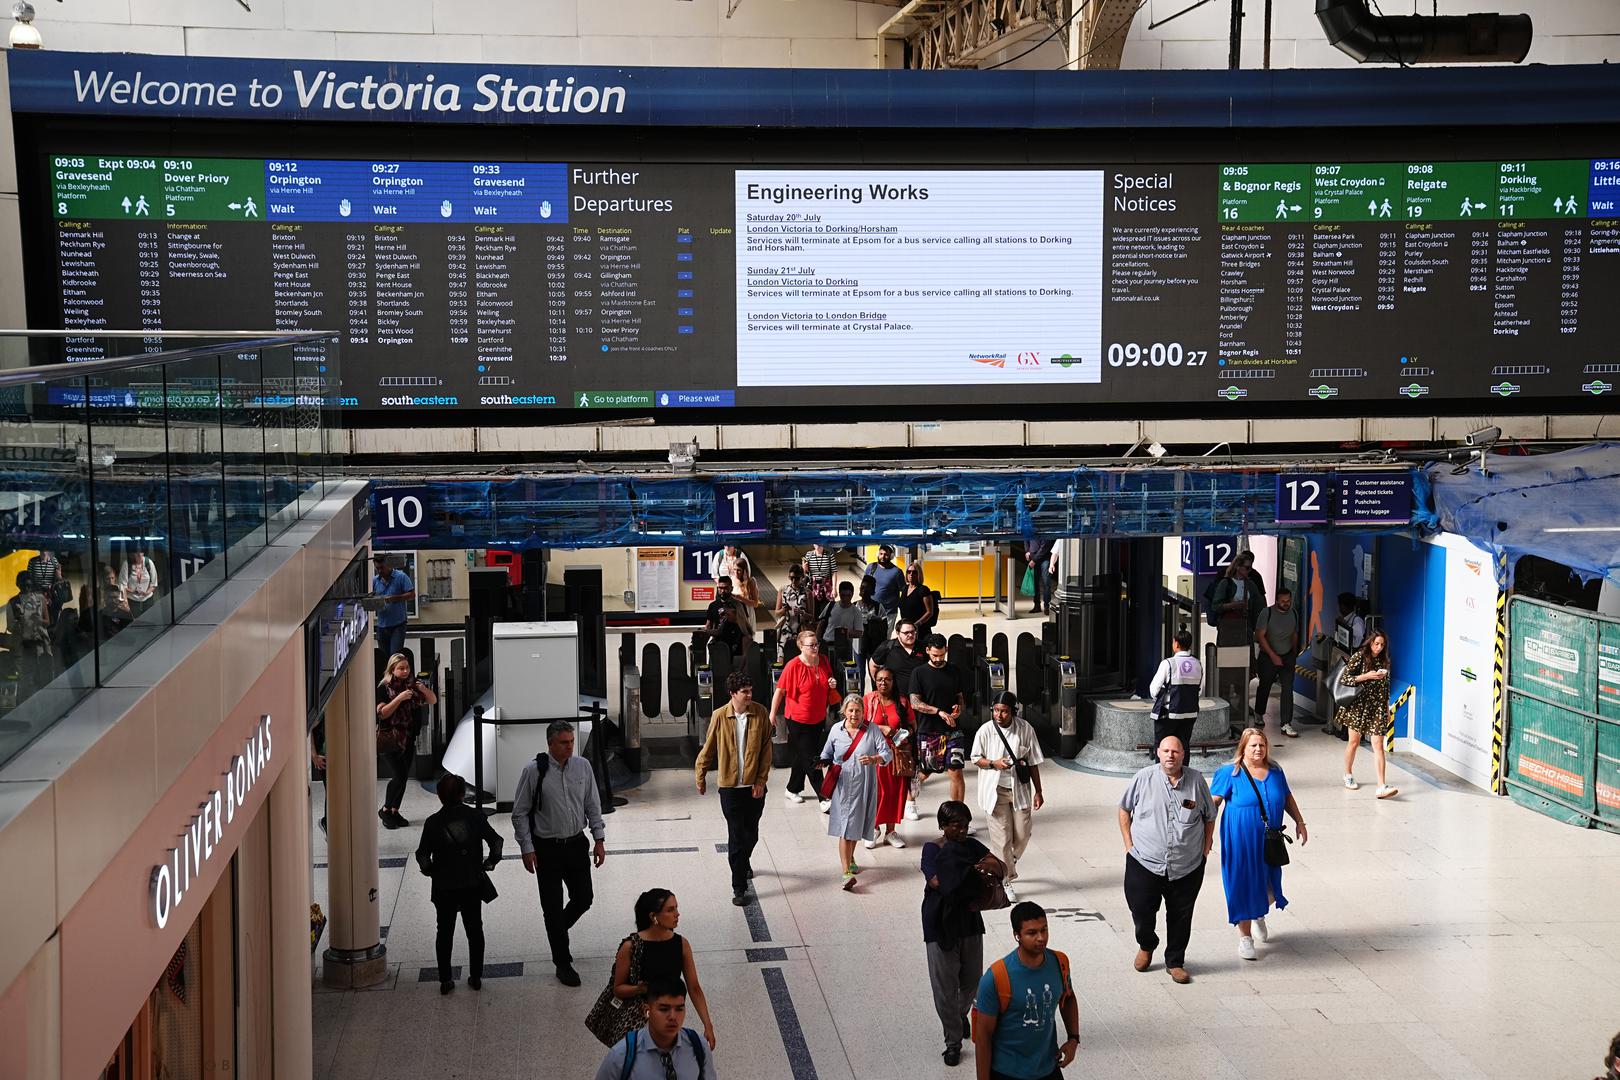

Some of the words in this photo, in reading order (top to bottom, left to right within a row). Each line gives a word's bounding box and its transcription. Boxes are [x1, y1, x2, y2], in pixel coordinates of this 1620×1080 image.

[74, 71, 236, 106] Welcome
[249, 79, 282, 107] to
[294, 70, 461, 111] Victoria
[473, 75, 626, 113] Station
[55, 158, 85, 167] 09:03
[99, 159, 124, 171] Expt
[127, 160, 156, 169] 09:04
[164, 161, 192, 170] 09:10
[269, 163, 297, 172] 09:12
[372, 164, 399, 173] 09:27
[473, 165, 500, 174] 09:33
[1408, 165, 1433, 174] 09:08
[1501, 164, 1525, 172] 09:11
[1595, 161, 1620, 170] 09:16
[1224, 167, 1248, 175] 09:05
[1316, 166, 1341, 175] 09:07
[56, 171, 112, 181] Gravesend
[165, 174, 195, 182] Dover
[199, 174, 229, 185] Priory
[270, 175, 321, 186] Orpington
[574, 169, 639, 184] Further
[1501, 175, 1537, 186] Dorking
[68, 183, 110, 191] Bexleyheath
[373, 177, 423, 188] Orpington
[474, 178, 525, 186] Gravesend
[1114, 173, 1172, 193] Special
[1223, 182, 1231, 191] &
[1234, 182, 1271, 193] Bognor
[1274, 181, 1301, 193] Regis
[1315, 178, 1338, 186] West
[1340, 178, 1377, 188] Croydon
[1408, 180, 1447, 191] Reigate
[484, 189, 522, 197] Bexleyheath
[748, 184, 862, 204] Engineering
[869, 185, 929, 200] Works
[1509, 186, 1542, 194] Hackbridge
[59, 203, 67, 214] 8
[574, 196, 672, 216] Departures
[1115, 196, 1176, 211] Notices
[1592, 201, 1614, 210] Wait
[167, 204, 175, 216] 5
[271, 205, 295, 213] Wait
[373, 206, 397, 214] Wait
[474, 206, 497, 215] Wait
[1223, 208, 1238, 219] 16
[1315, 207, 1322, 218] 9
[1407, 206, 1422, 217] 19
[1500, 205, 1513, 216] 11
[747, 214, 784, 223] Saturday
[803, 214, 821, 223] July
[747, 225, 779, 233] London
[781, 225, 812, 233] Victoria
[815, 225, 823, 233] to
[825, 224, 898, 234] Dorking/Horsham
[747, 237, 782, 245] Services
[853, 237, 881, 245] Epsom
[954, 237, 980, 245] calling
[1040, 236, 1072, 245] Dorking
[747, 267, 780, 276] Sunday
[797, 267, 815, 276] July
[748, 278, 779, 286] London
[780, 278, 814, 286] Victoria
[815, 278, 823, 286] to
[825, 278, 858, 287] Dorking
[748, 312, 779, 320] London
[781, 312, 813, 320] Victoria
[816, 312, 823, 320] to
[826, 312, 857, 320] London
[859, 312, 887, 321] Bridge
[853, 323, 881, 332] Crystal
[378, 337, 413, 345] Orpington
[1108, 343, 1183, 367] 09:00
[1187, 351, 1207, 366] 27
[382, 396, 458, 405] southeastern
[481, 395, 556, 405] southeastern
[616, 395, 648, 404] platform
[1286, 481, 1320, 510] 12
[381, 496, 422, 528] 10
[727, 492, 754, 522] 11
[1181, 540, 1191, 564] 12
[1205, 543, 1231, 567] 12
[692, 551, 713, 575] 11
[156, 790, 222, 929] OLIVER
[227, 714, 272, 824] BONAS
